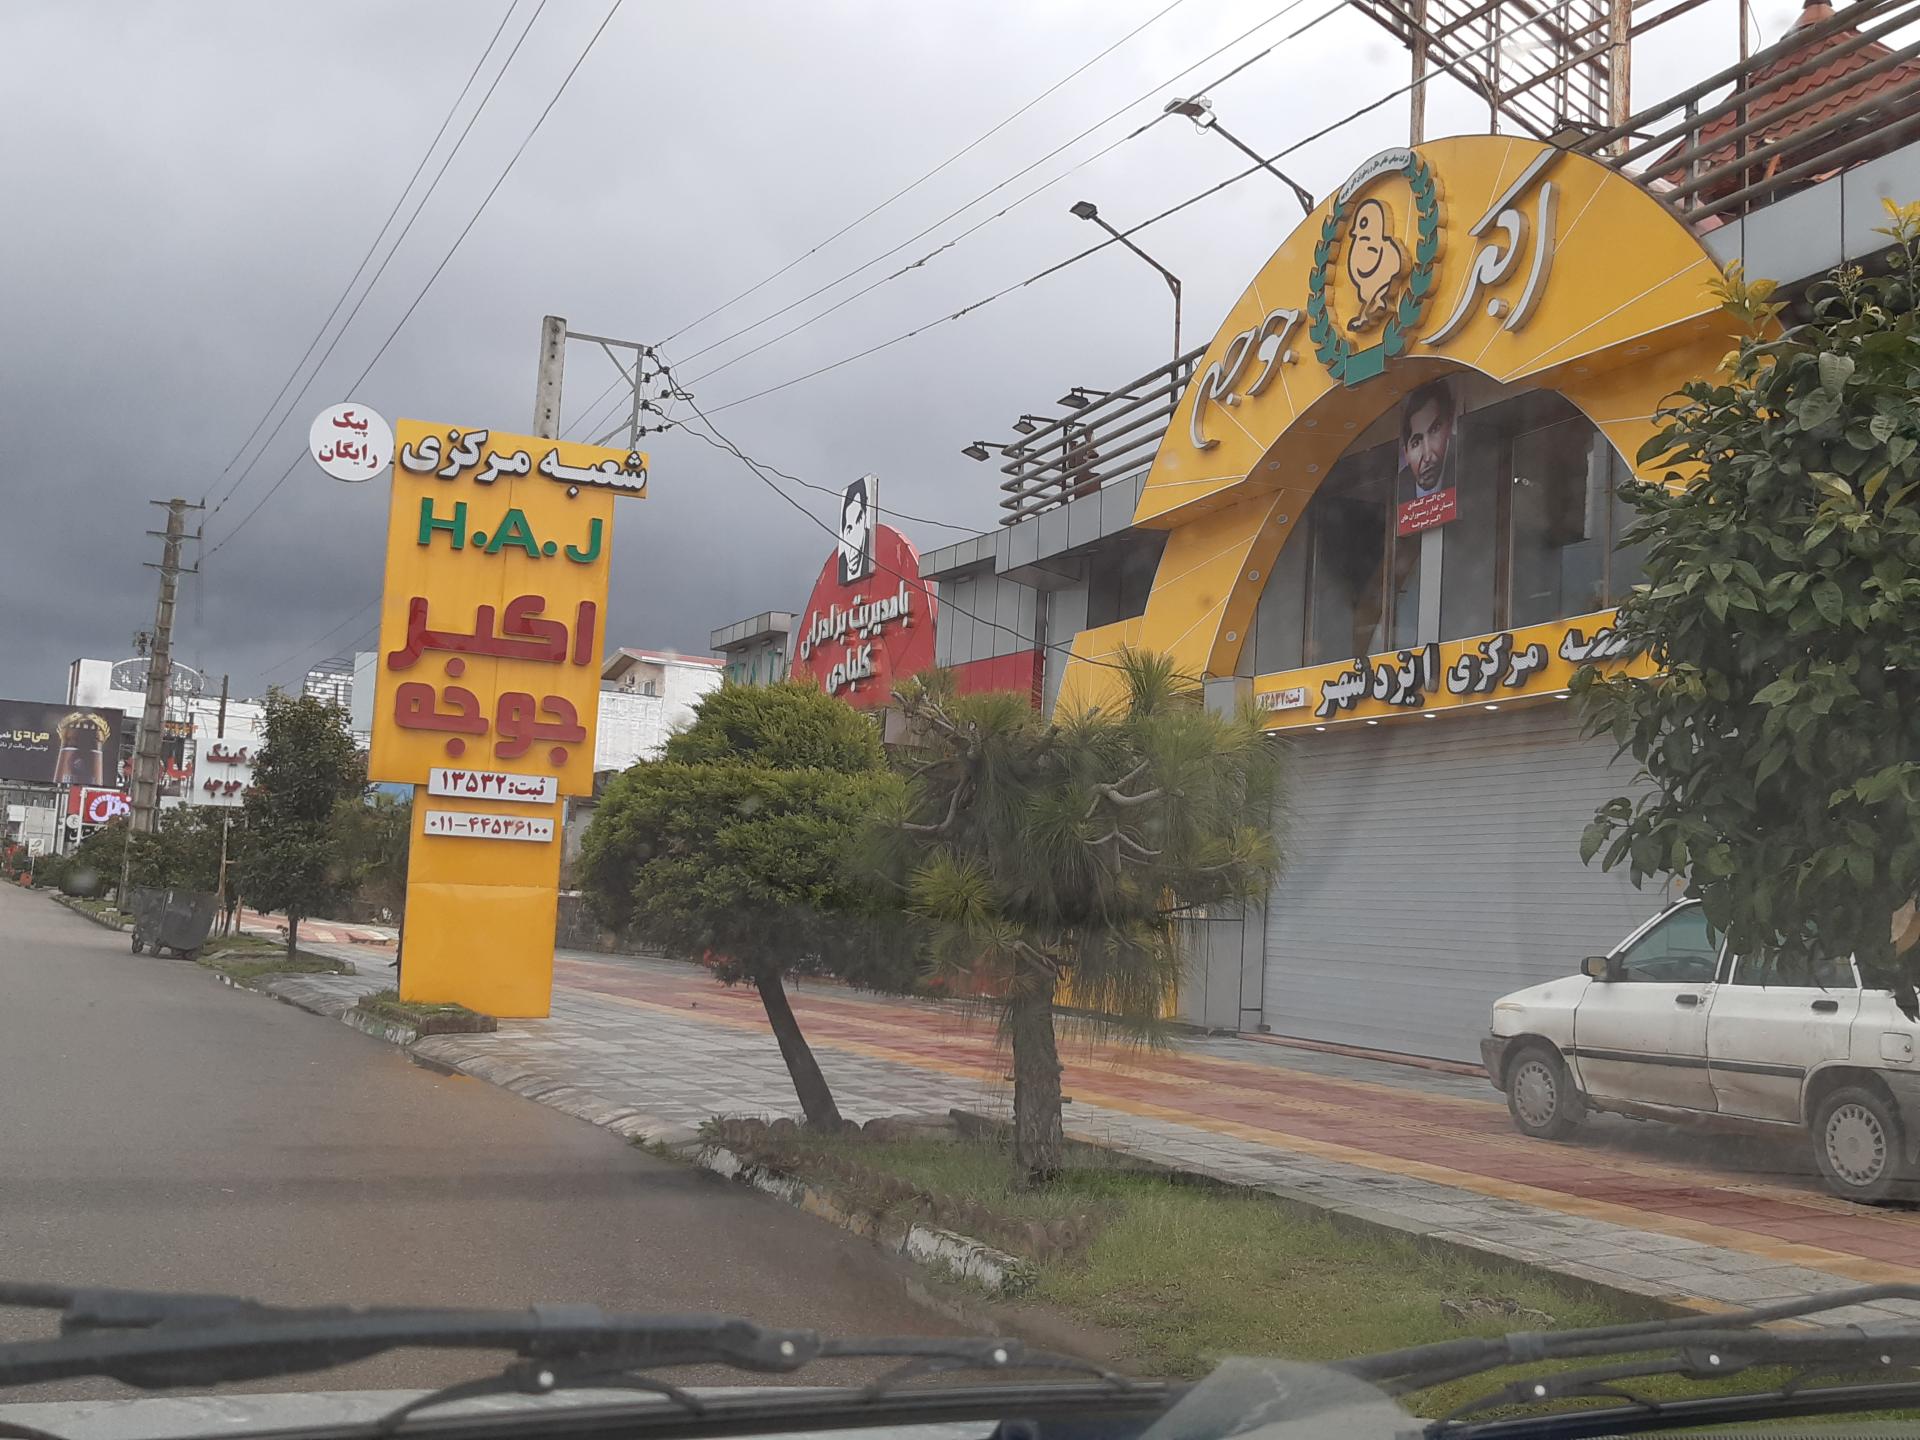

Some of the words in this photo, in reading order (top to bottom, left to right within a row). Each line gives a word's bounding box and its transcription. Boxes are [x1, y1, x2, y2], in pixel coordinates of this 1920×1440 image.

[1420, 148, 1563, 346] اکبر
[1189, 308, 1301, 450] جوجه
[318, 440, 378, 468] رایگان
[332, 411, 368, 437] پیک
[401, 428, 532, 483] مرکزی
[538, 448, 647, 498] شعبه
[417, 496, 603, 564] H.A.J
[387, 594, 597, 677] اکبر
[800, 603, 847, 661] برادران
[1447, 633, 1548, 694] مرکزی
[394, 681, 587, 766] جوجه
